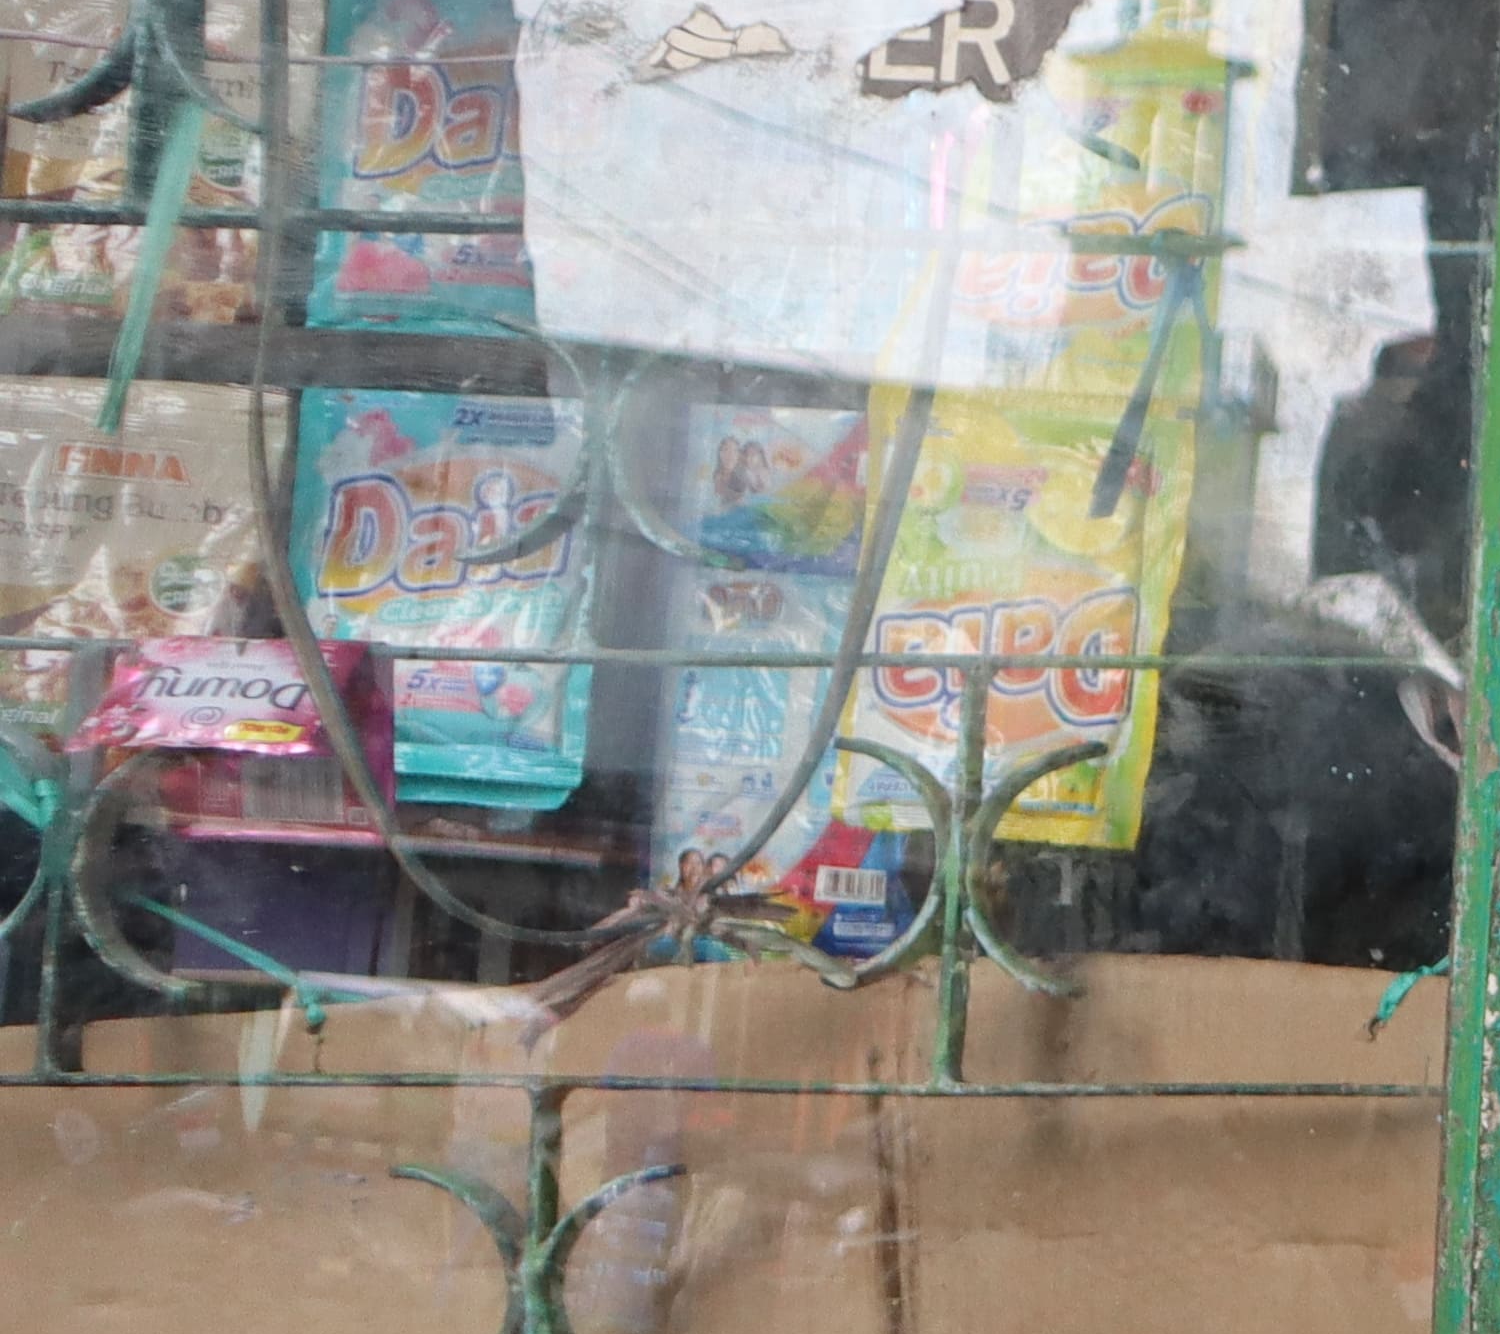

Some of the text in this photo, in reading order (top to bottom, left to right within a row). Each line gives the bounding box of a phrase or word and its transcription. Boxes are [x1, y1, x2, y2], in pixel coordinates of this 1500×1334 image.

[353, 57, 520, 180] Da
[317, 471, 573, 598] Daia
[136, 666, 308, 712] Downy
[874, 586, 1140, 727] Daia
